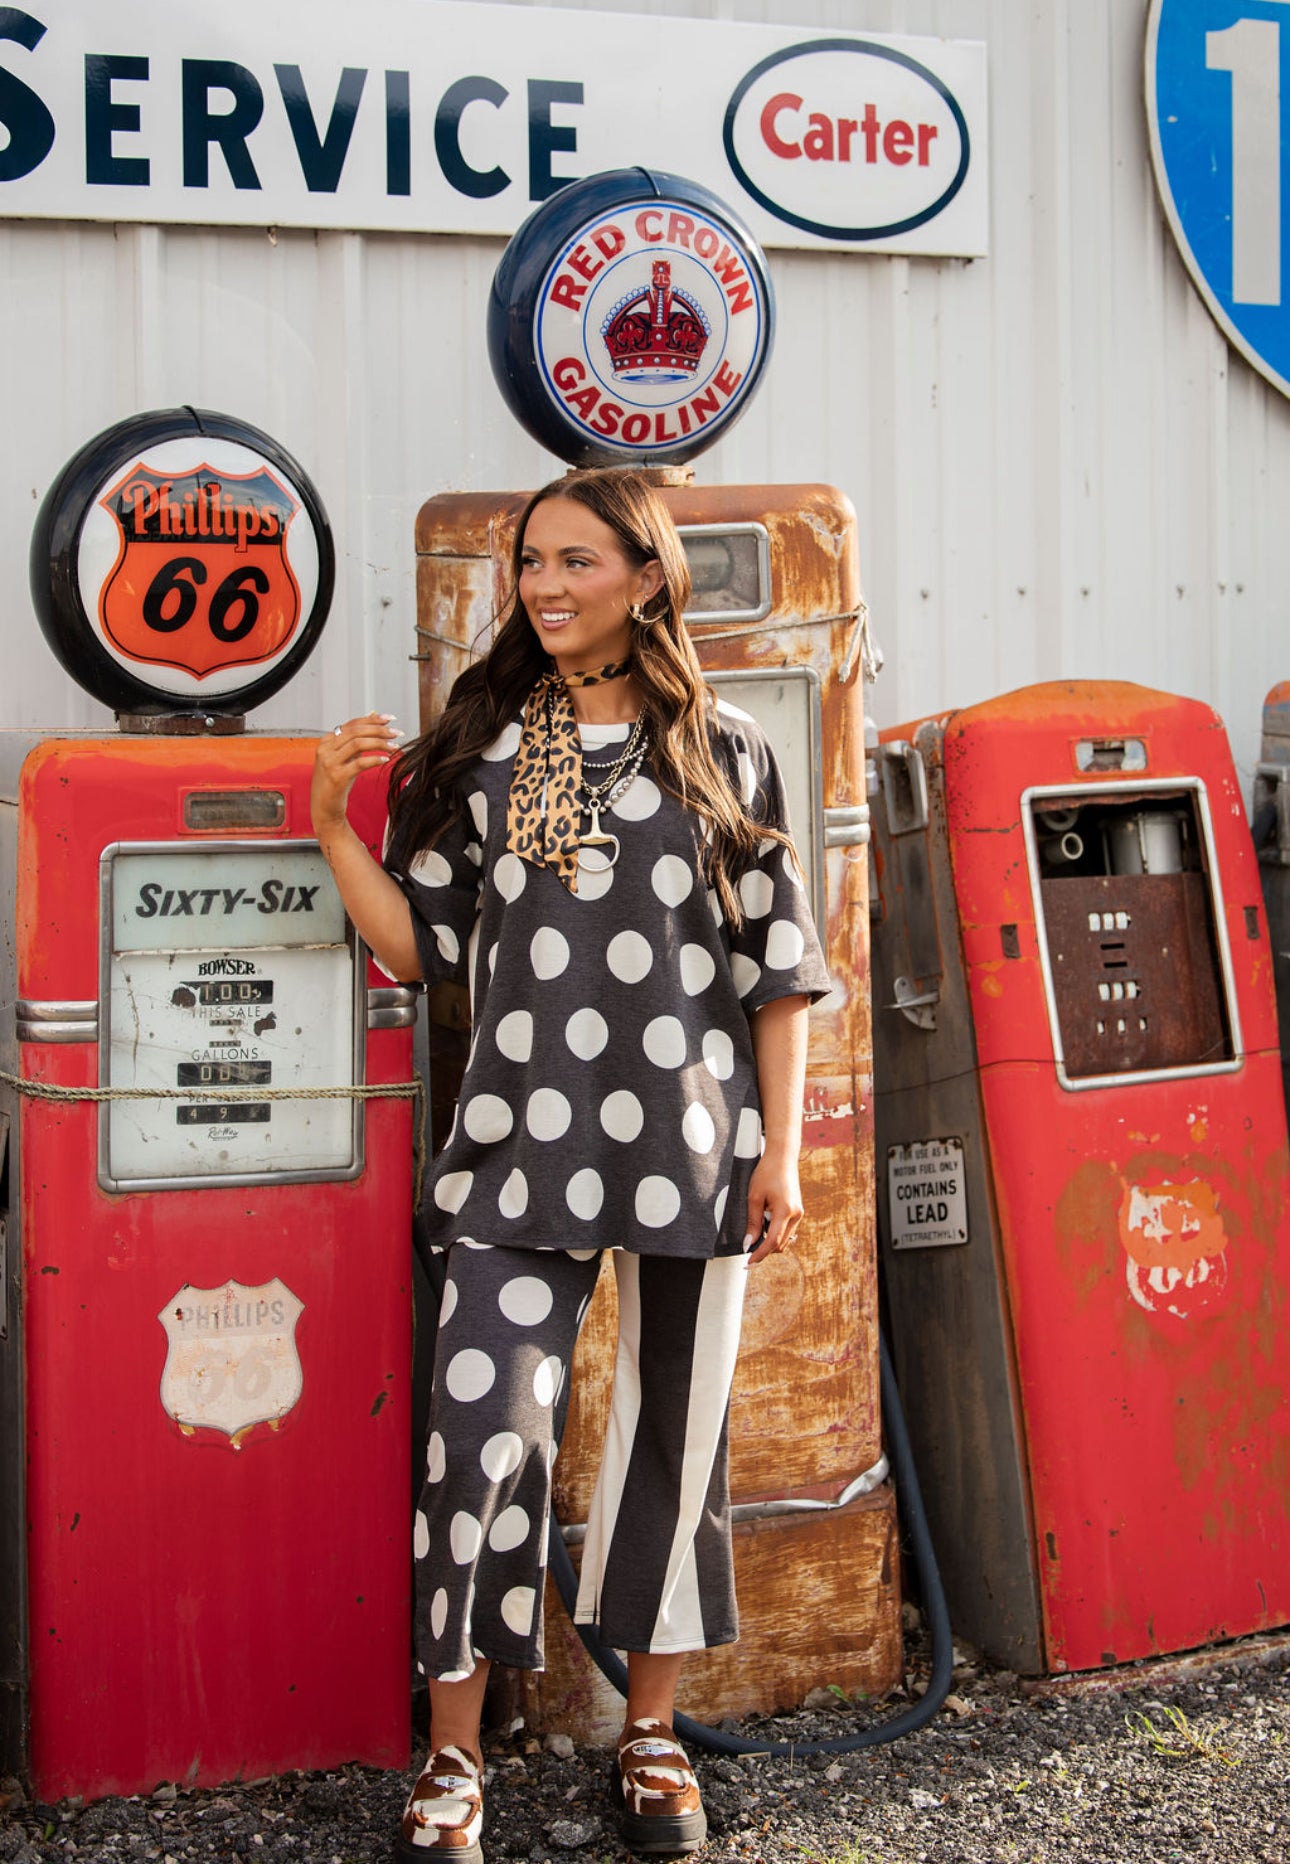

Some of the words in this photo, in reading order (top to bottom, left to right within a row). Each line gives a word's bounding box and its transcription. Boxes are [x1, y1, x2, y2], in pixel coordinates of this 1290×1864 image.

[0, 6, 585, 203] SERVICE
[760, 92, 938, 167] Carter
[550, 224, 627, 313] RED
[635, 210, 754, 316] CROWN
[552, 356, 743, 444] GASOLINE
[122, 479, 280, 554] Phillips
[142, 556, 271, 644] 66
[135, 879, 321, 918] SIXTY-SIX
[198, 959, 256, 976] BOWSER
[228, 1005, 262, 1018] SALE
[191, 1047, 259, 1062] GALLONS
[896, 1179, 957, 1201] CONTAINS
[907, 1202, 949, 1225] LEAD
[180, 1301, 285, 1331] PHILLIPS
